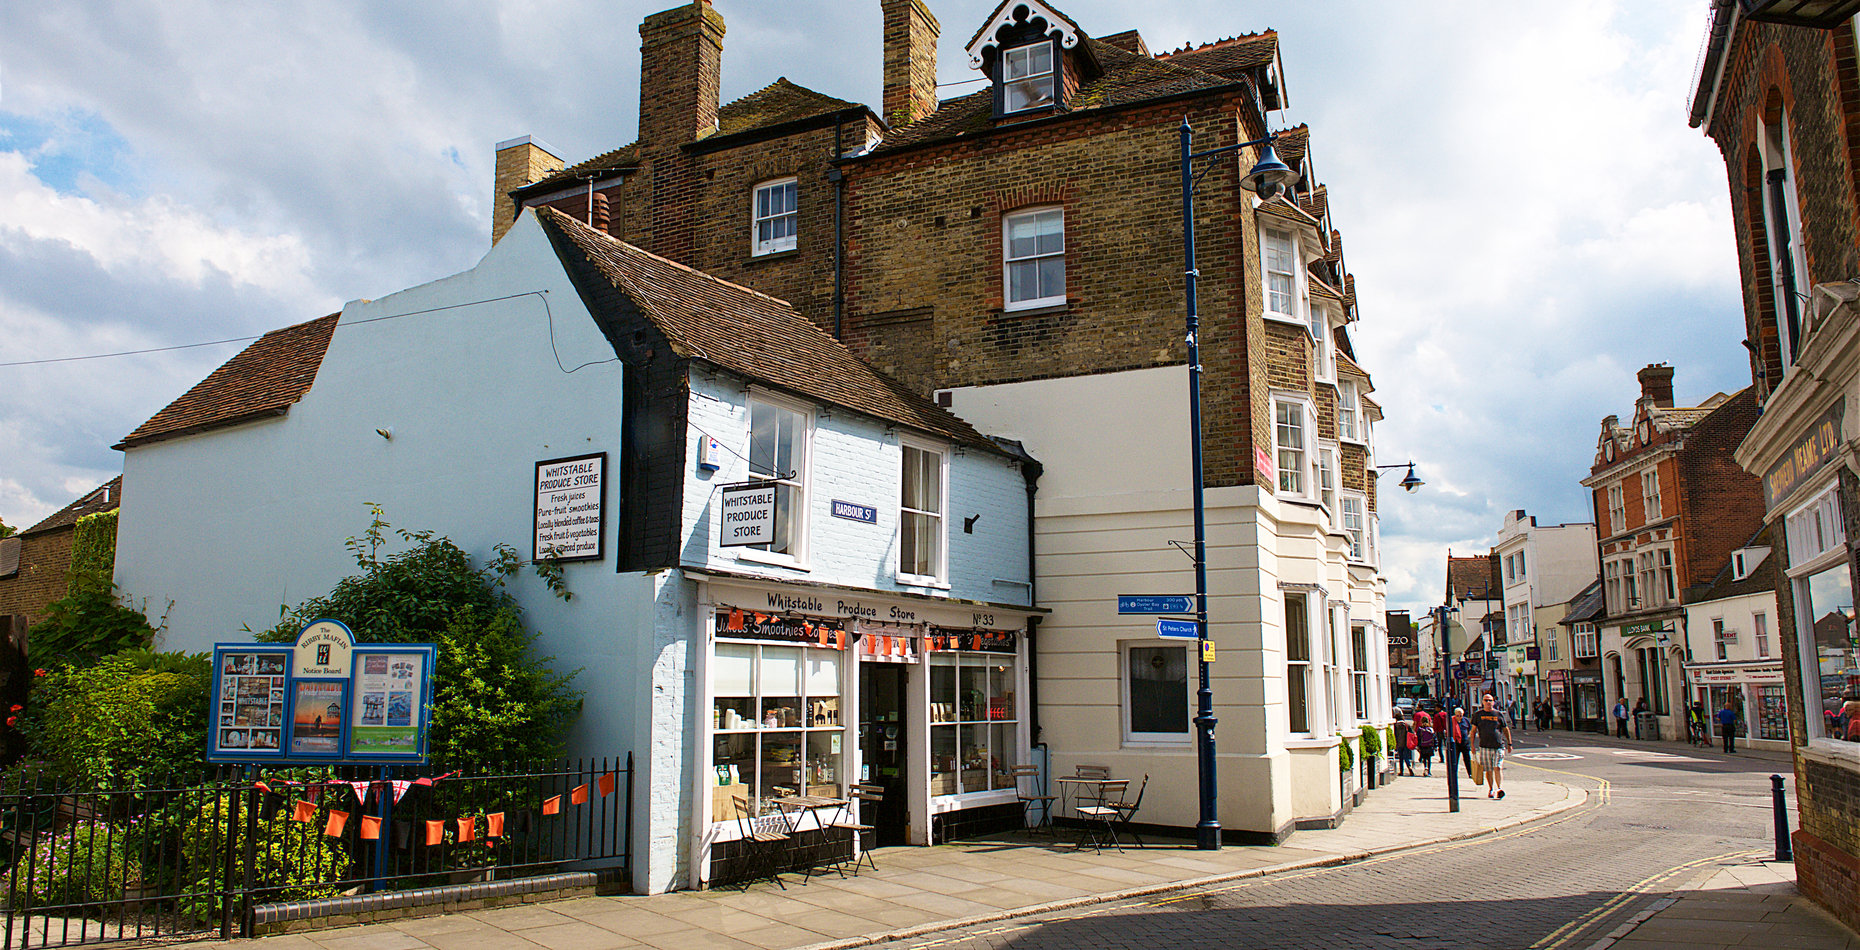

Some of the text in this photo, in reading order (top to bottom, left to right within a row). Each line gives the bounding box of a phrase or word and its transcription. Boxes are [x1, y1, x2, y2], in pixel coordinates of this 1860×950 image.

[1818, 421, 1838, 456] LTD.
[545, 462, 594, 478] WHITSTABLE
[539, 473, 599, 491] PRODUCE STORE
[550, 491, 586, 506] Fresh juices
[724, 493, 773, 508] WHITSTABLE
[538, 501, 600, 517] Pure-fruit smoothies
[726, 509, 769, 523] PRODUCE
[835, 502, 864, 519] HARBOUR
[537, 519, 554, 531] Locally
[553, 517, 572, 528] blended
[589, 515, 600, 524] teas
[539, 532, 554, 542] Fresh
[553, 531, 566, 540] fruit
[569, 527, 598, 541] vegetables
[733, 525, 762, 538] STORE
[575, 541, 596, 554] produce
[767, 592, 915, 620] Whitstable Produce Store
[982, 614, 994, 626] 33
[1626, 625, 1640, 634] LLOYDS
